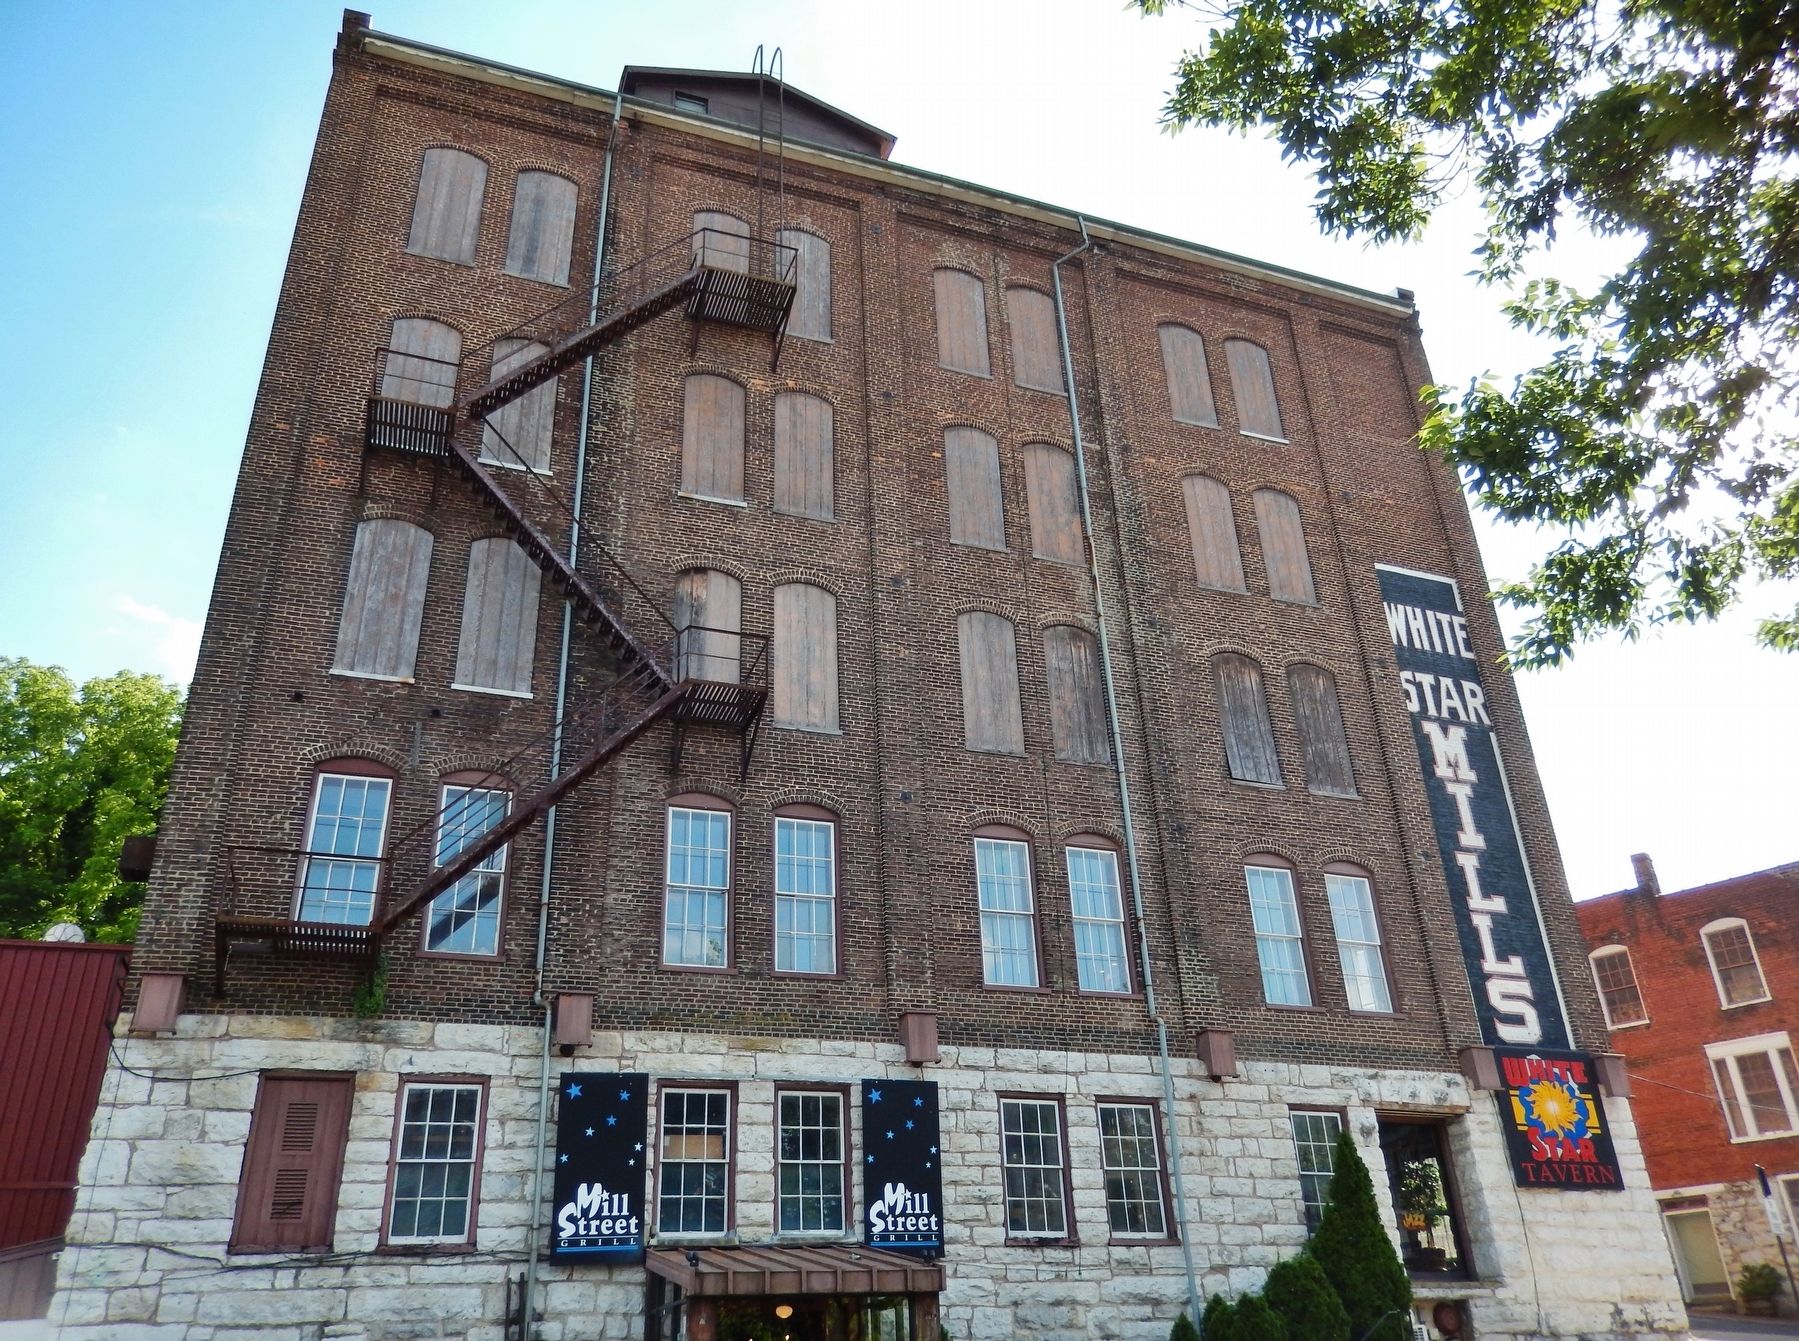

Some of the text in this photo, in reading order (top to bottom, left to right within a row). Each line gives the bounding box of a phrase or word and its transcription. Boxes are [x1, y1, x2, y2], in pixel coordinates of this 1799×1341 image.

[1383, 602, 1475, 659] WHITE
[1399, 671, 1491, 725] STAR
[1420, 720, 1543, 1045] MILLS
[1502, 1057, 1589, 1086] WHITE
[1527, 1126, 1599, 1163] STAR
[1522, 1162, 1616, 1184] TAVERN
[576, 1183, 630, 1218] Mill
[884, 1182, 930, 1215] Mill
[558, 1202, 639, 1238] Street
[869, 1199, 939, 1233] Street
[560, 1238, 637, 1247] GRILL
[873, 1234, 938, 1242] GRILL
